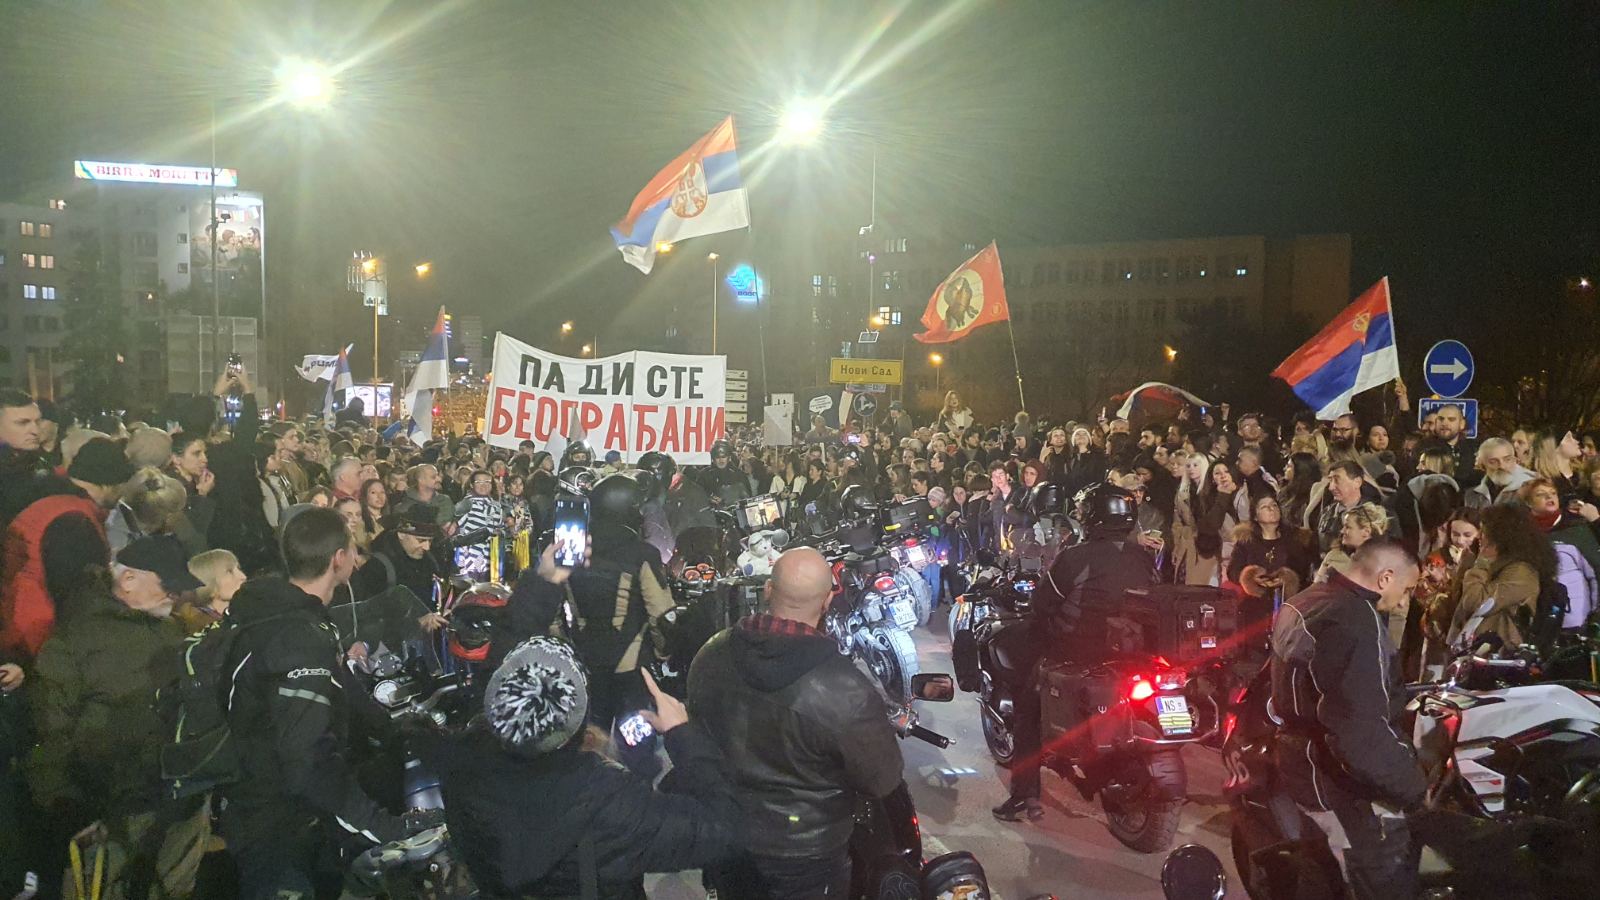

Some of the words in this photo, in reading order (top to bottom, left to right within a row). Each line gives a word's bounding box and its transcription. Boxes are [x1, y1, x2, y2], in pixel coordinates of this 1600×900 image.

[518, 353, 565, 393] ПА
[578, 362, 634, 396] ДИ
[646, 364, 704, 399] СТЕ
[840, 364, 867, 375] Нови
[871, 365, 892, 376] Сад
[490, 387, 725, 453] БЕОГРАЂАНИ
[1164, 699, 1176, 712] NS
